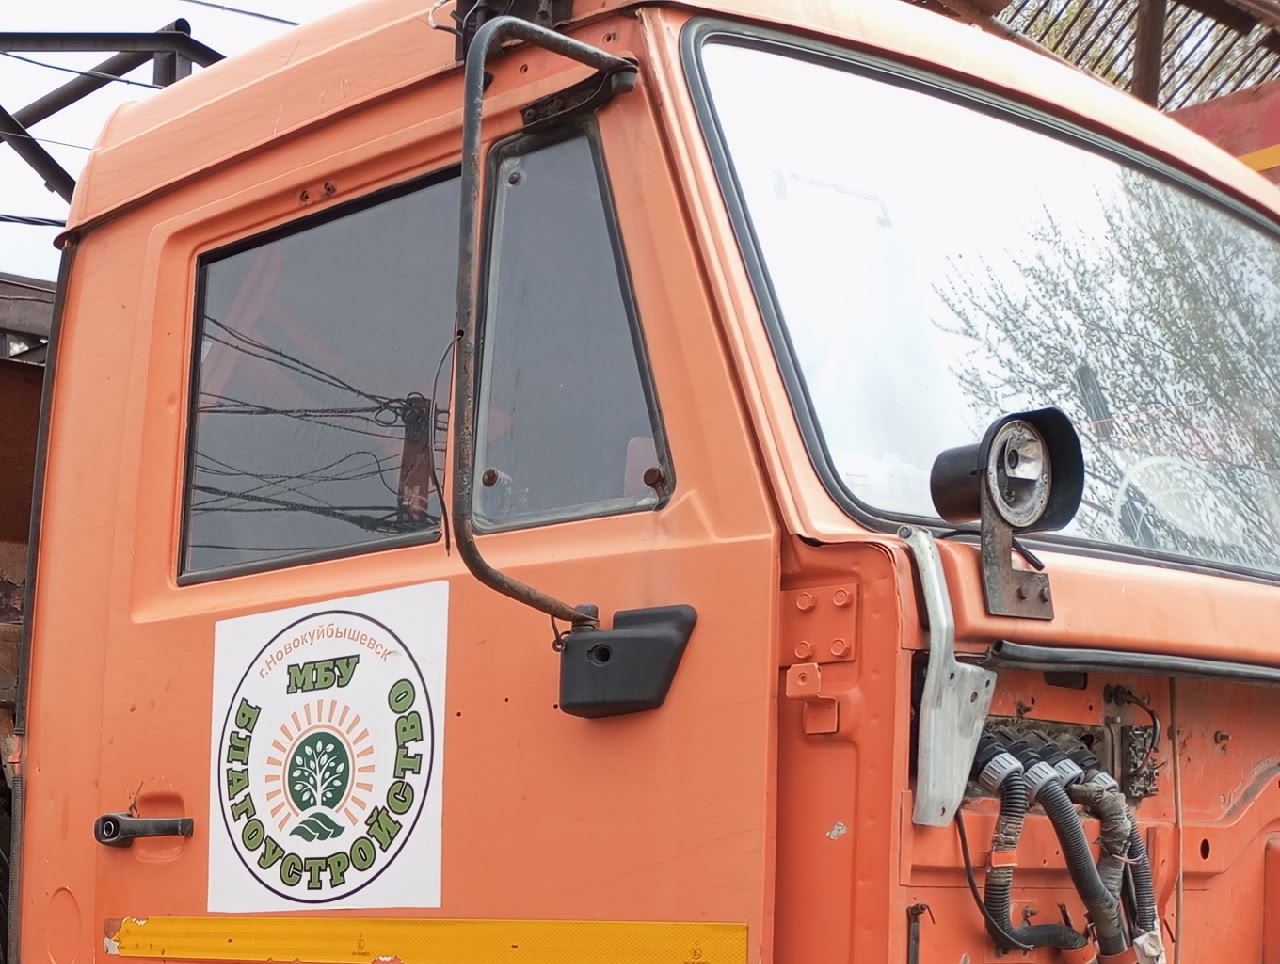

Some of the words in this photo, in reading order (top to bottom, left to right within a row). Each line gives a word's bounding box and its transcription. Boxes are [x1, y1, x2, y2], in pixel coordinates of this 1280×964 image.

[259, 623, 392, 679] г.Новокуйбышевск
[286, 654, 361, 694] МБУ
[227, 678, 424, 890] БЛАГОУСТРОЙСТВО
